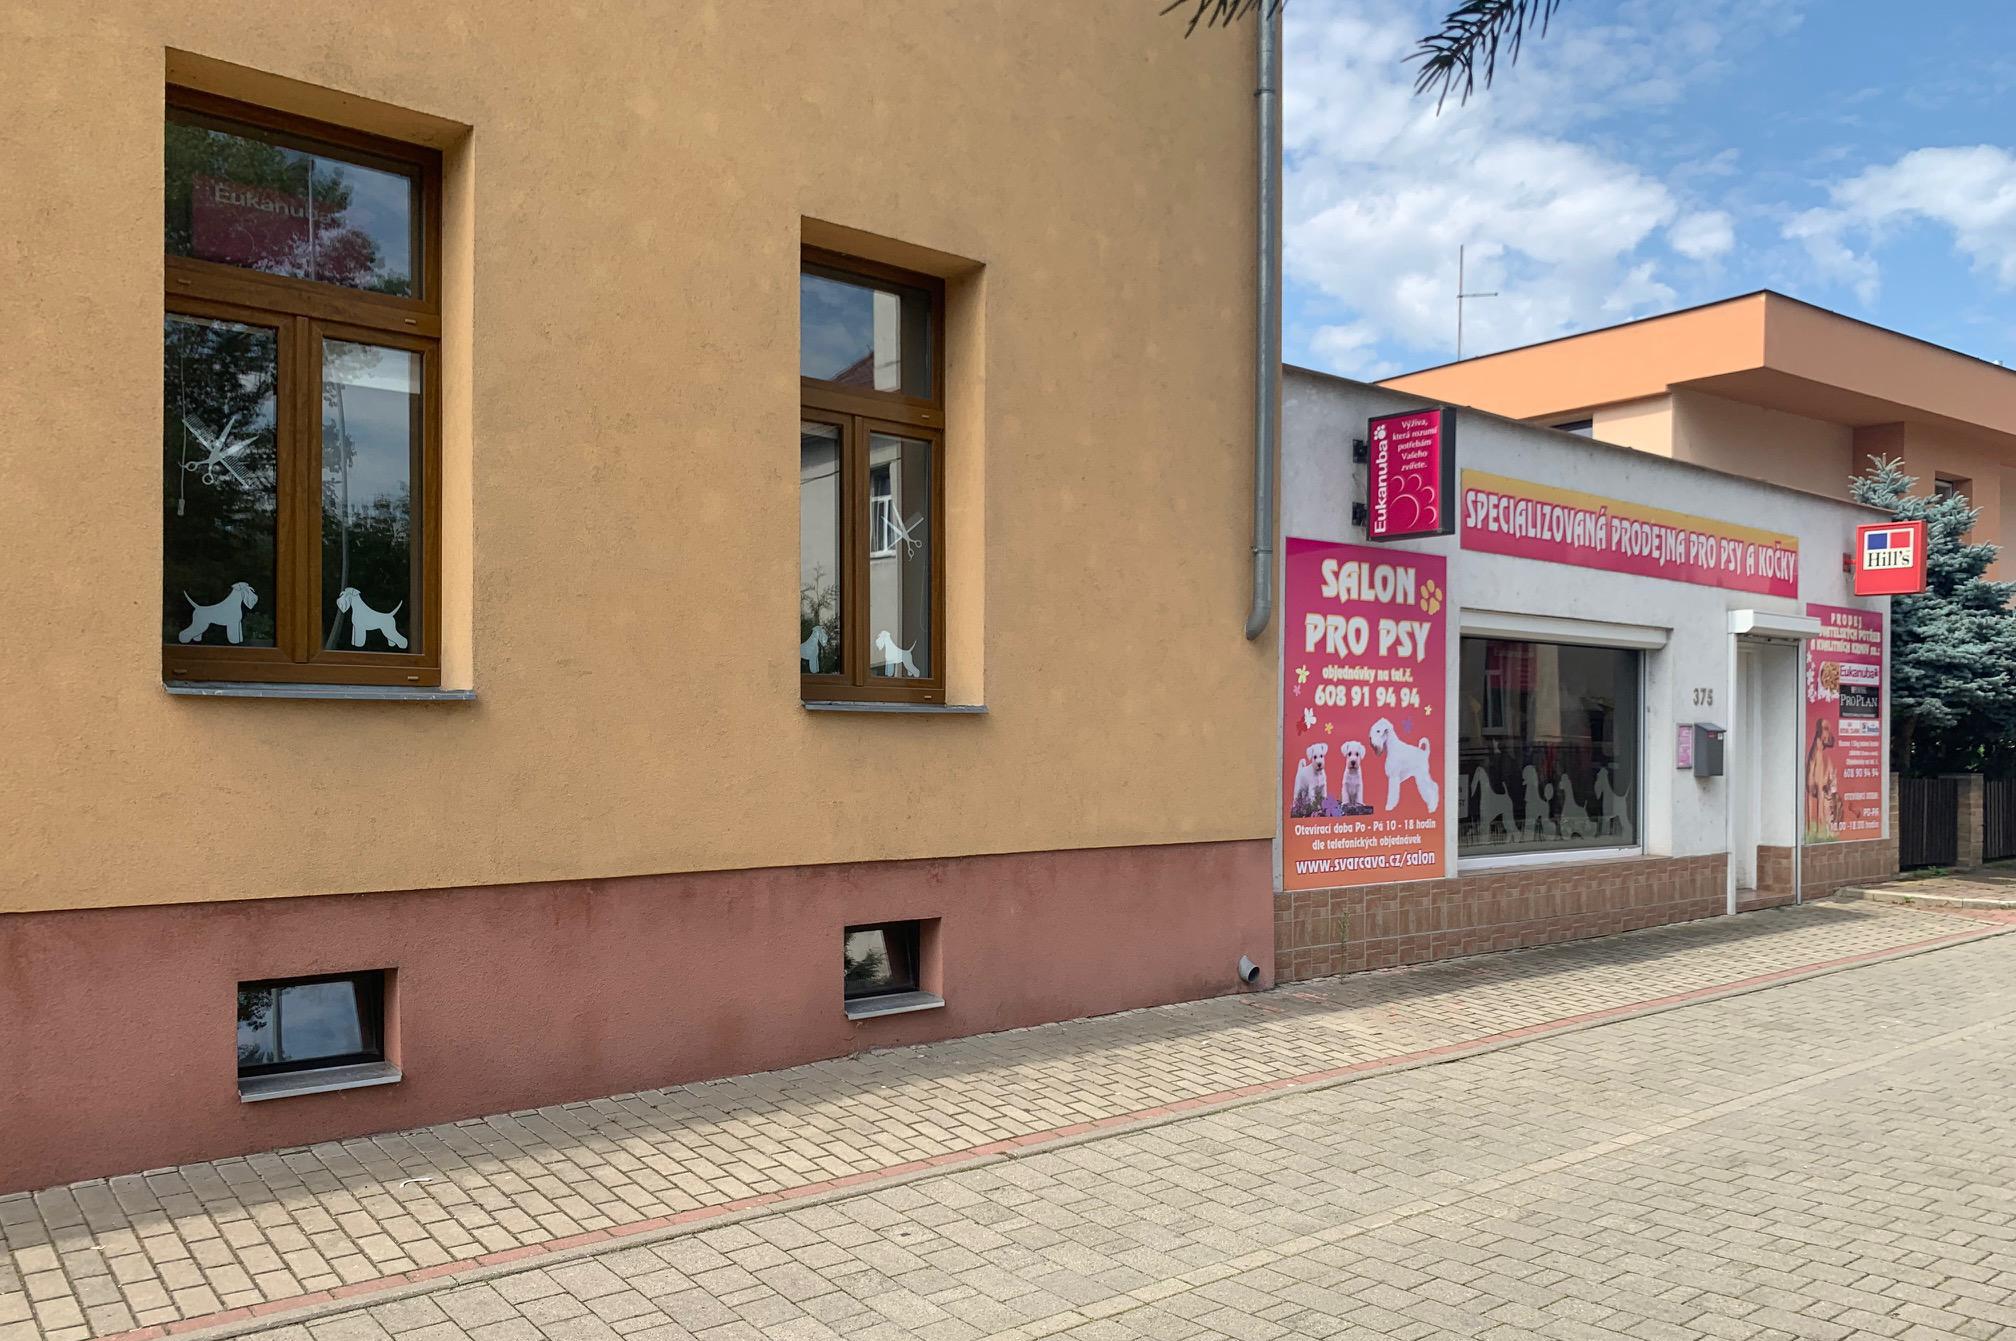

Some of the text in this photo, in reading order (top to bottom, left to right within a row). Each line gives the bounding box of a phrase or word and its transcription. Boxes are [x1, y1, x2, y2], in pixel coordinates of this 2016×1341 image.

[1374, 440, 1388, 533] Eukanuba
[1466, 490, 1796, 583] SPECIALIZOVANÁ PRODEJNA PRO PSY A KOČKY
[1867, 550, 1910, 567] Hill's
[1321, 558, 1416, 605] SALON
[1304, 612, 1432, 663] PRO PSY
[1322, 664, 1376, 683] objednávky
[1377, 670, 1389, 681] na
[1840, 664, 1876, 679] Eukanuba
[1314, 684, 1420, 708] 608 91 94 94
[1294, 824, 1331, 835] Otevírací
[1333, 823, 1353, 834] doba
[1355, 822, 1365, 832] Po
[1373, 820, 1383, 831] Pá
[1386, 820, 1396, 830] 10
[1404, 819, 1414, 829] 18
[1416, 819, 1436, 829] hodin
[1312, 840, 1325, 850] dle
[1327, 836, 1378, 849] telefonických
[1296, 850, 1435, 874] www.svarcava.cz/salon
